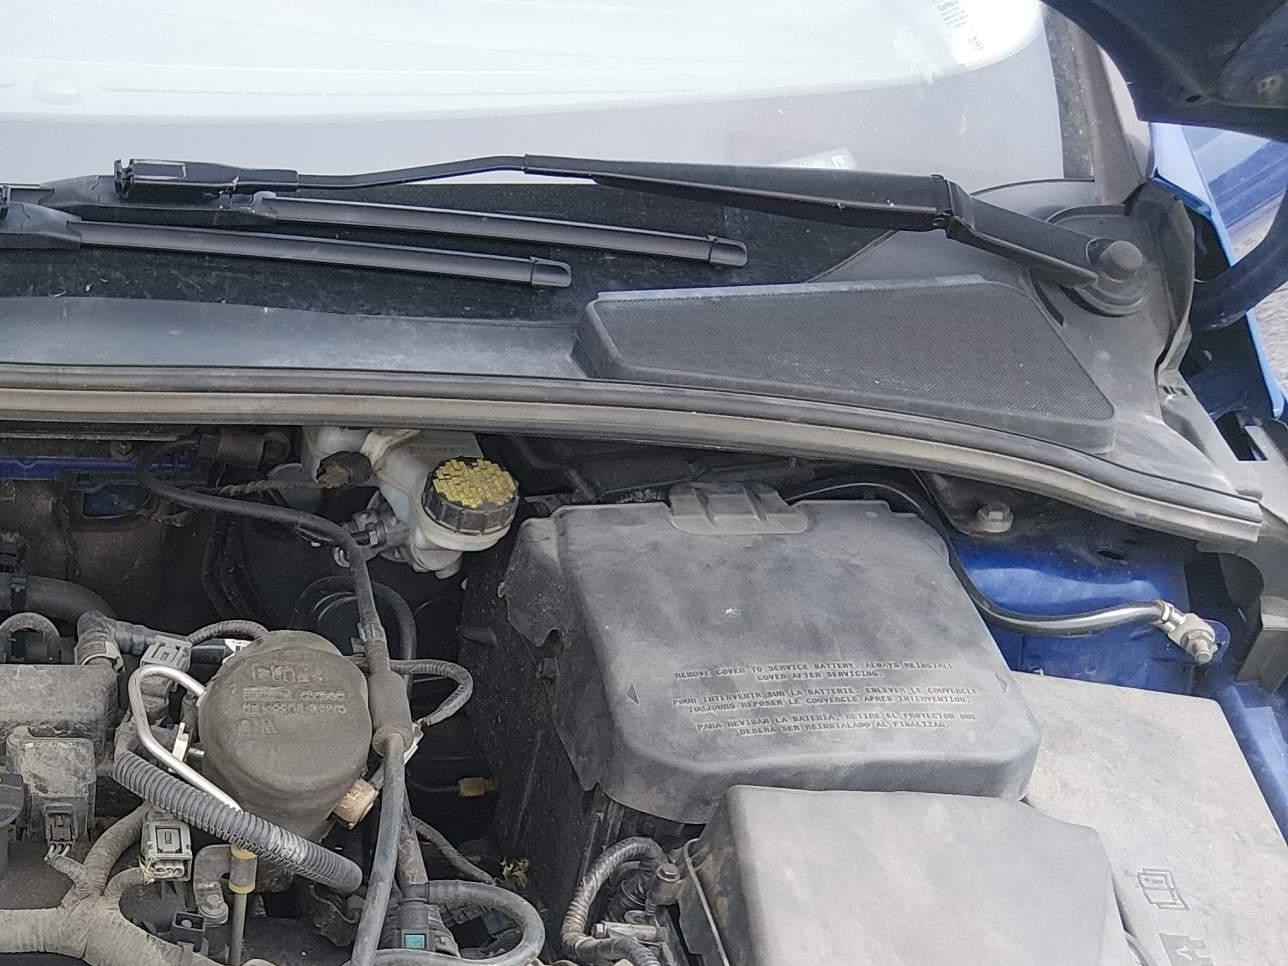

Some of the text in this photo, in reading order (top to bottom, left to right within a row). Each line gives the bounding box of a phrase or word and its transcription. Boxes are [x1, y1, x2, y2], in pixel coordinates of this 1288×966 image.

[674, 670, 711, 679] REMOVE
[715, 666, 745, 676] COVER
[752, 665, 763, 673] TO
[767, 663, 808, 672] SERVICE
[865, 661, 900, 670] ALWAYS
[757, 673, 787, 682] COVER
[792, 671, 821, 679] AFTER
[673, 697, 697, 706] POUR
[703, 692, 761, 703] INTERVENIR
[791, 688, 804, 696] LA
[865, 686, 906, 695] ENLEVER
[688, 703, 736, 713] TOUJOURS
[741, 699, 783, 709] REPOSER
[806, 696, 859, 705] COUVERCLE
[864, 695, 893, 703] APRES
[727, 719, 770, 728] REVISAR
[903, 711, 955, 720] PROTECTOR
[781, 724, 800, 732] SER
[805, 721, 871, 731] REINSTALADO
[876, 720, 888, 728] AL
